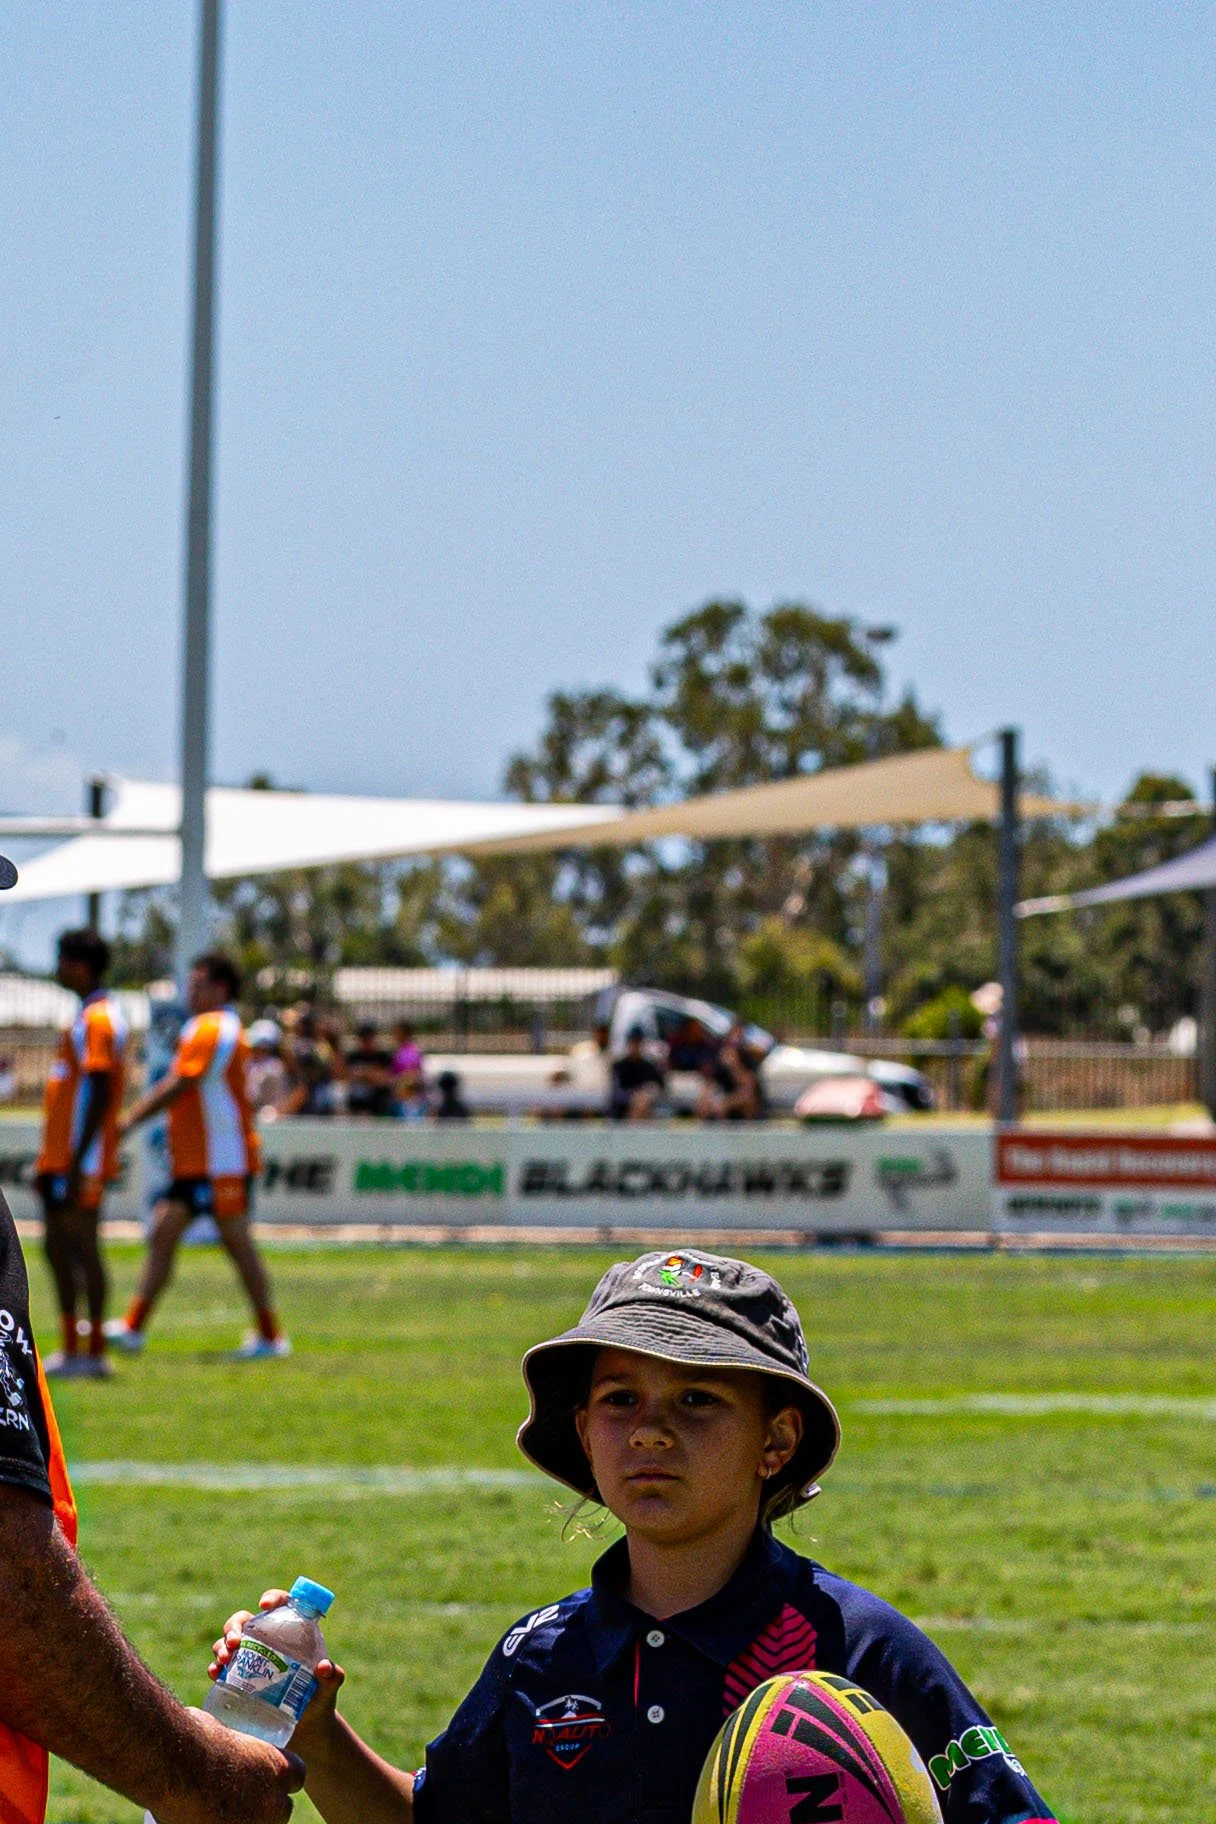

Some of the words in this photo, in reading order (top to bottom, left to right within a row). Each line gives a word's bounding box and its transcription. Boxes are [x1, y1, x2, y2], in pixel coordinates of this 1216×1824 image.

[519, 1156, 852, 1200] BLACKHAWKS
[234, 1653, 274, 1680] RANKLIN
[242, 1649, 270, 1667] MOUNT
